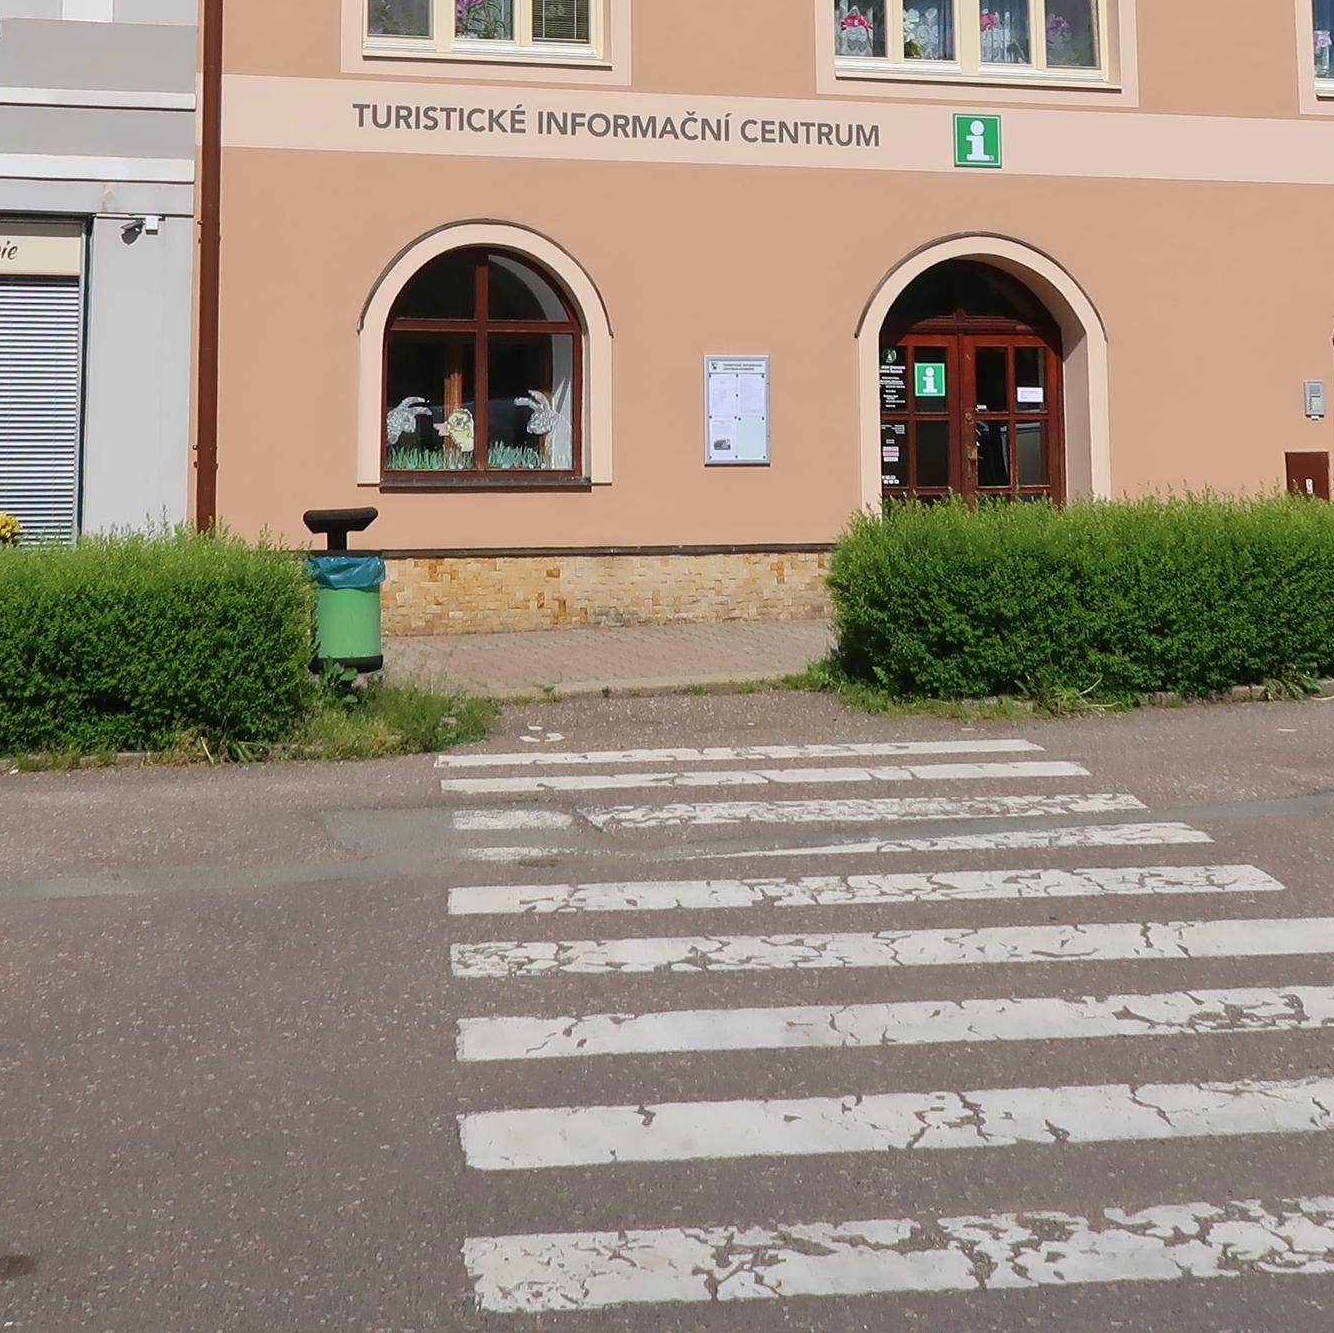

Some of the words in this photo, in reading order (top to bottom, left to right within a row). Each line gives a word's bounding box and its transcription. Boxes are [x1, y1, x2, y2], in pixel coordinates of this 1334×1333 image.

[352, 103, 527, 134] TURISTICKÉ
[537, 110, 733, 142] INFORMAČNÍ
[740, 118, 880, 148] CENTRUM
